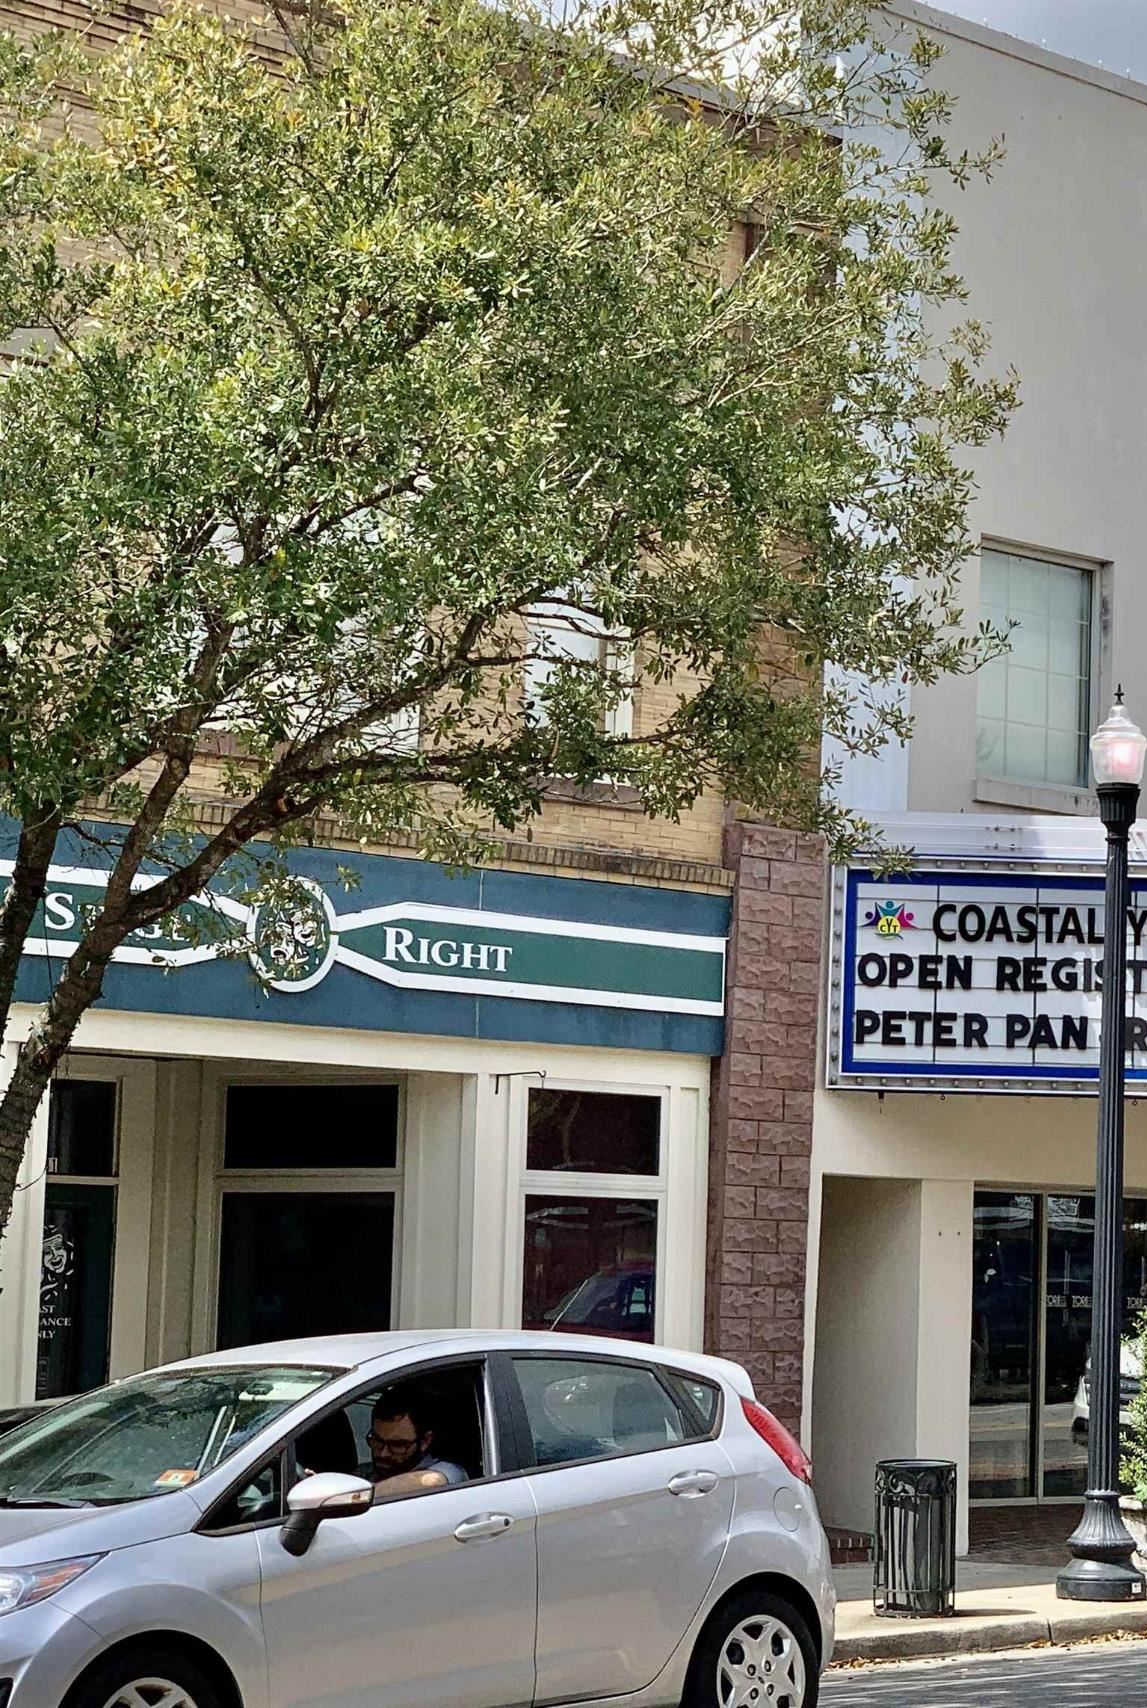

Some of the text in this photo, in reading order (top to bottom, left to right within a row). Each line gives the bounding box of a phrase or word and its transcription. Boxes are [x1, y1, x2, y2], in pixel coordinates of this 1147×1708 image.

[880, 918, 898, 932] CYT
[933, 904, 1105, 944] COASTAL
[382, 926, 513, 972] RIGHT
[858, 953, 973, 990] OPEN
[855, 1010, 989, 1048] PETER
[1005, 1013, 1089, 1050] PAN
[40, 1317, 72, 1326] ANCE
